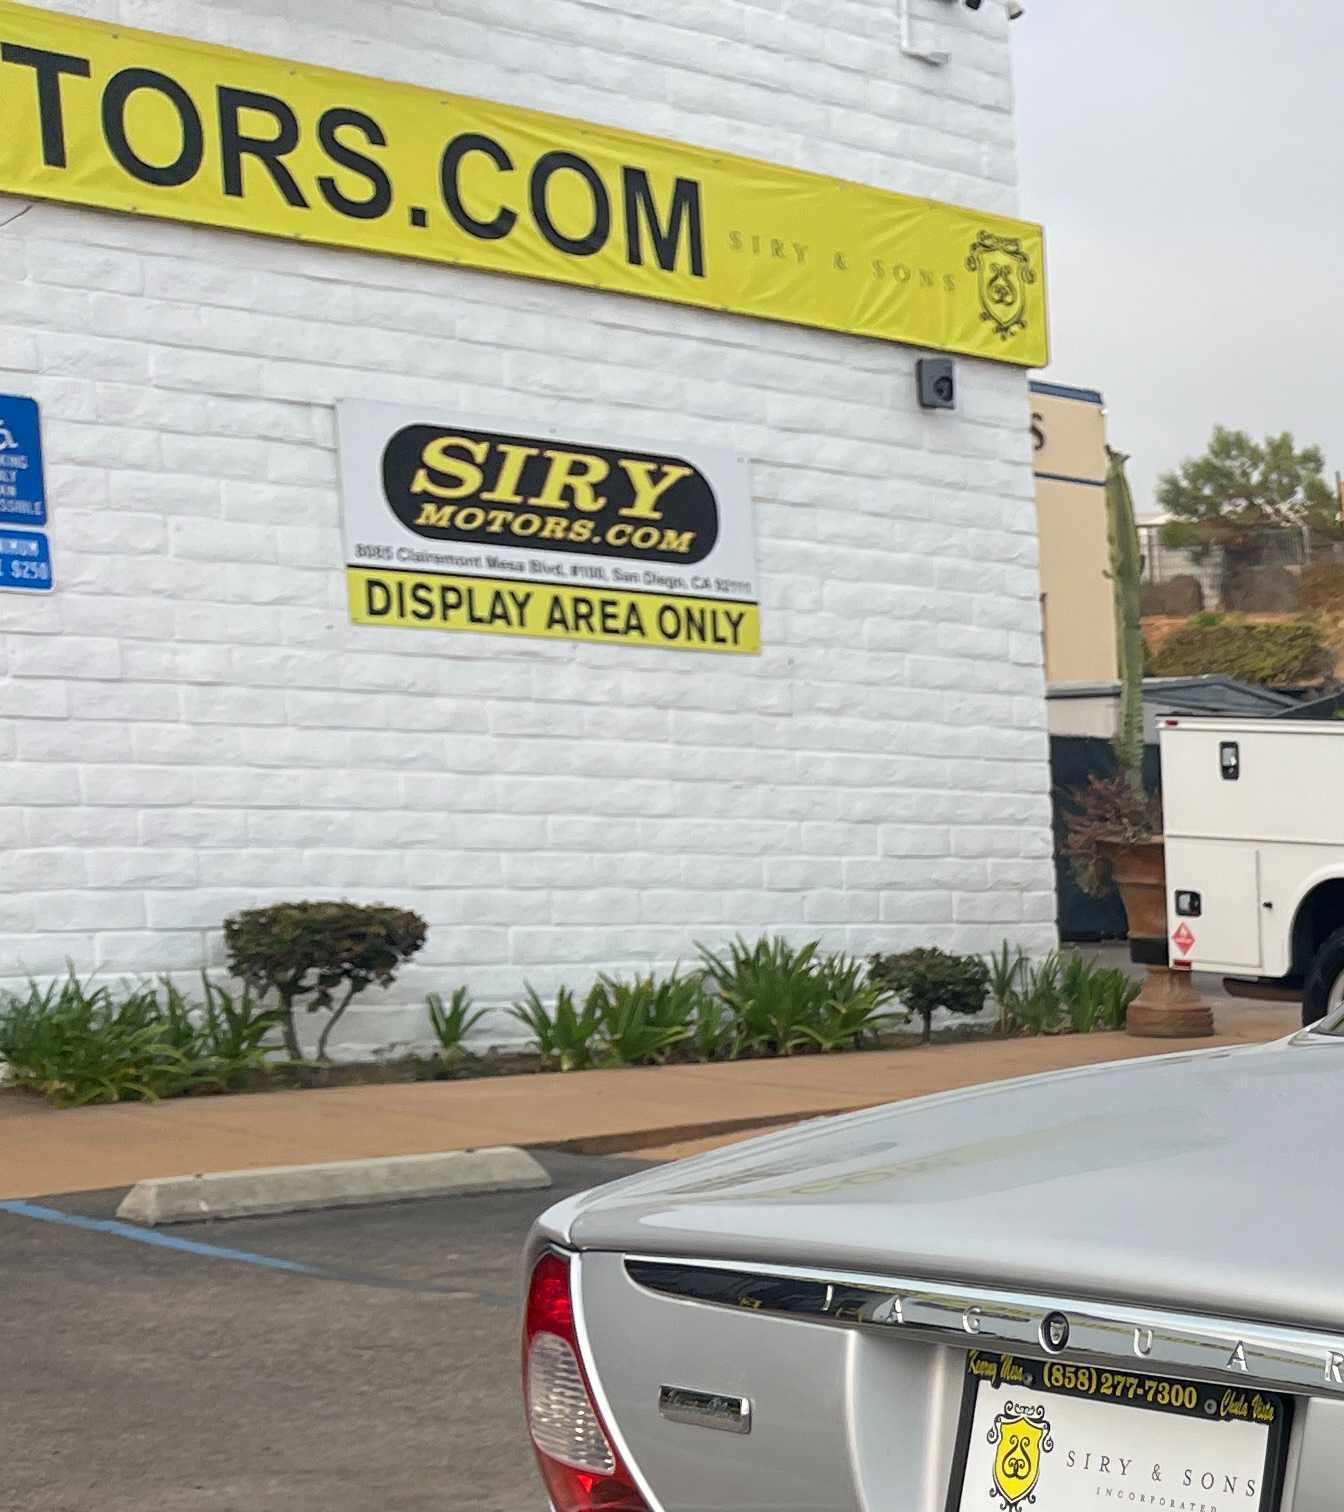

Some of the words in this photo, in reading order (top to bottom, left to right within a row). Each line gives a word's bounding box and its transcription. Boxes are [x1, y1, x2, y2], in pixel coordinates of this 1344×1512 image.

[0, 42, 706, 278] TORS.COM
[728, 230, 809, 265] SIRY
[831, 251, 848, 272] &
[871, 259, 957, 293] SONS
[410, 434, 694, 521] SIRY
[415, 502, 696, 555] MOTORS.COM
[366, 579, 532, 627] DISPLAY
[547, 595, 645, 637] AREA
[658, 604, 745, 645] ONLY
[1066, 1450, 1133, 1477] SIRY
[1151, 1463, 1163, 1483] &
[1182, 1469, 1257, 1498] SONS
